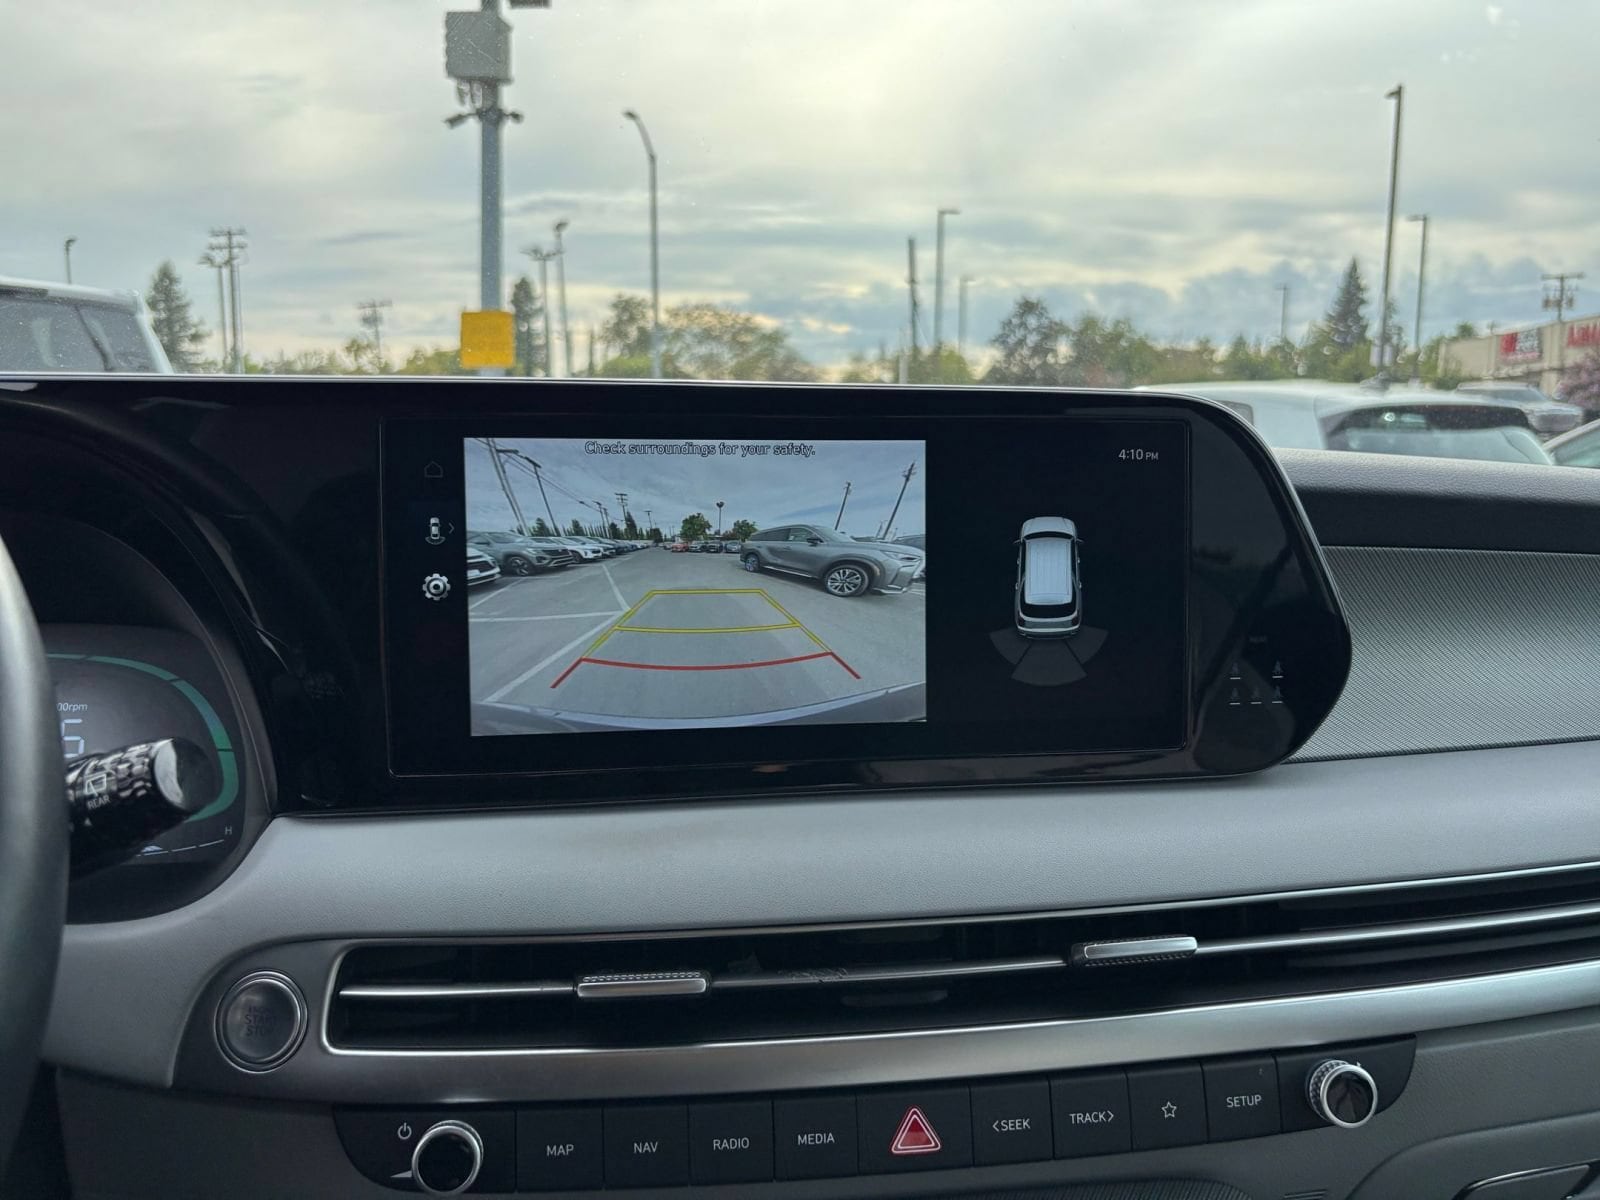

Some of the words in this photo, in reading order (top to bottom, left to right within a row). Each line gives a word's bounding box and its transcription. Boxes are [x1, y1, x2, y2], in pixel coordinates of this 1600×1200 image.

[584, 440, 626, 455] Check
[628, 441, 717, 457] surroundings
[719, 442, 739, 455] for
[740, 444, 771, 458] your
[773, 443, 816, 458] safety.
[1118, 448, 1144, 460] 4:10
[1145, 451, 1159, 460] PM
[224, 826, 233, 835] H
[1226, 1094, 1262, 1108] SETUP
[712, 1137, 750, 1151] RADIO
[797, 1132, 835, 1146] MEDIA
[546, 1144, 575, 1157] MAP
[633, 1141, 659, 1154] NAV
